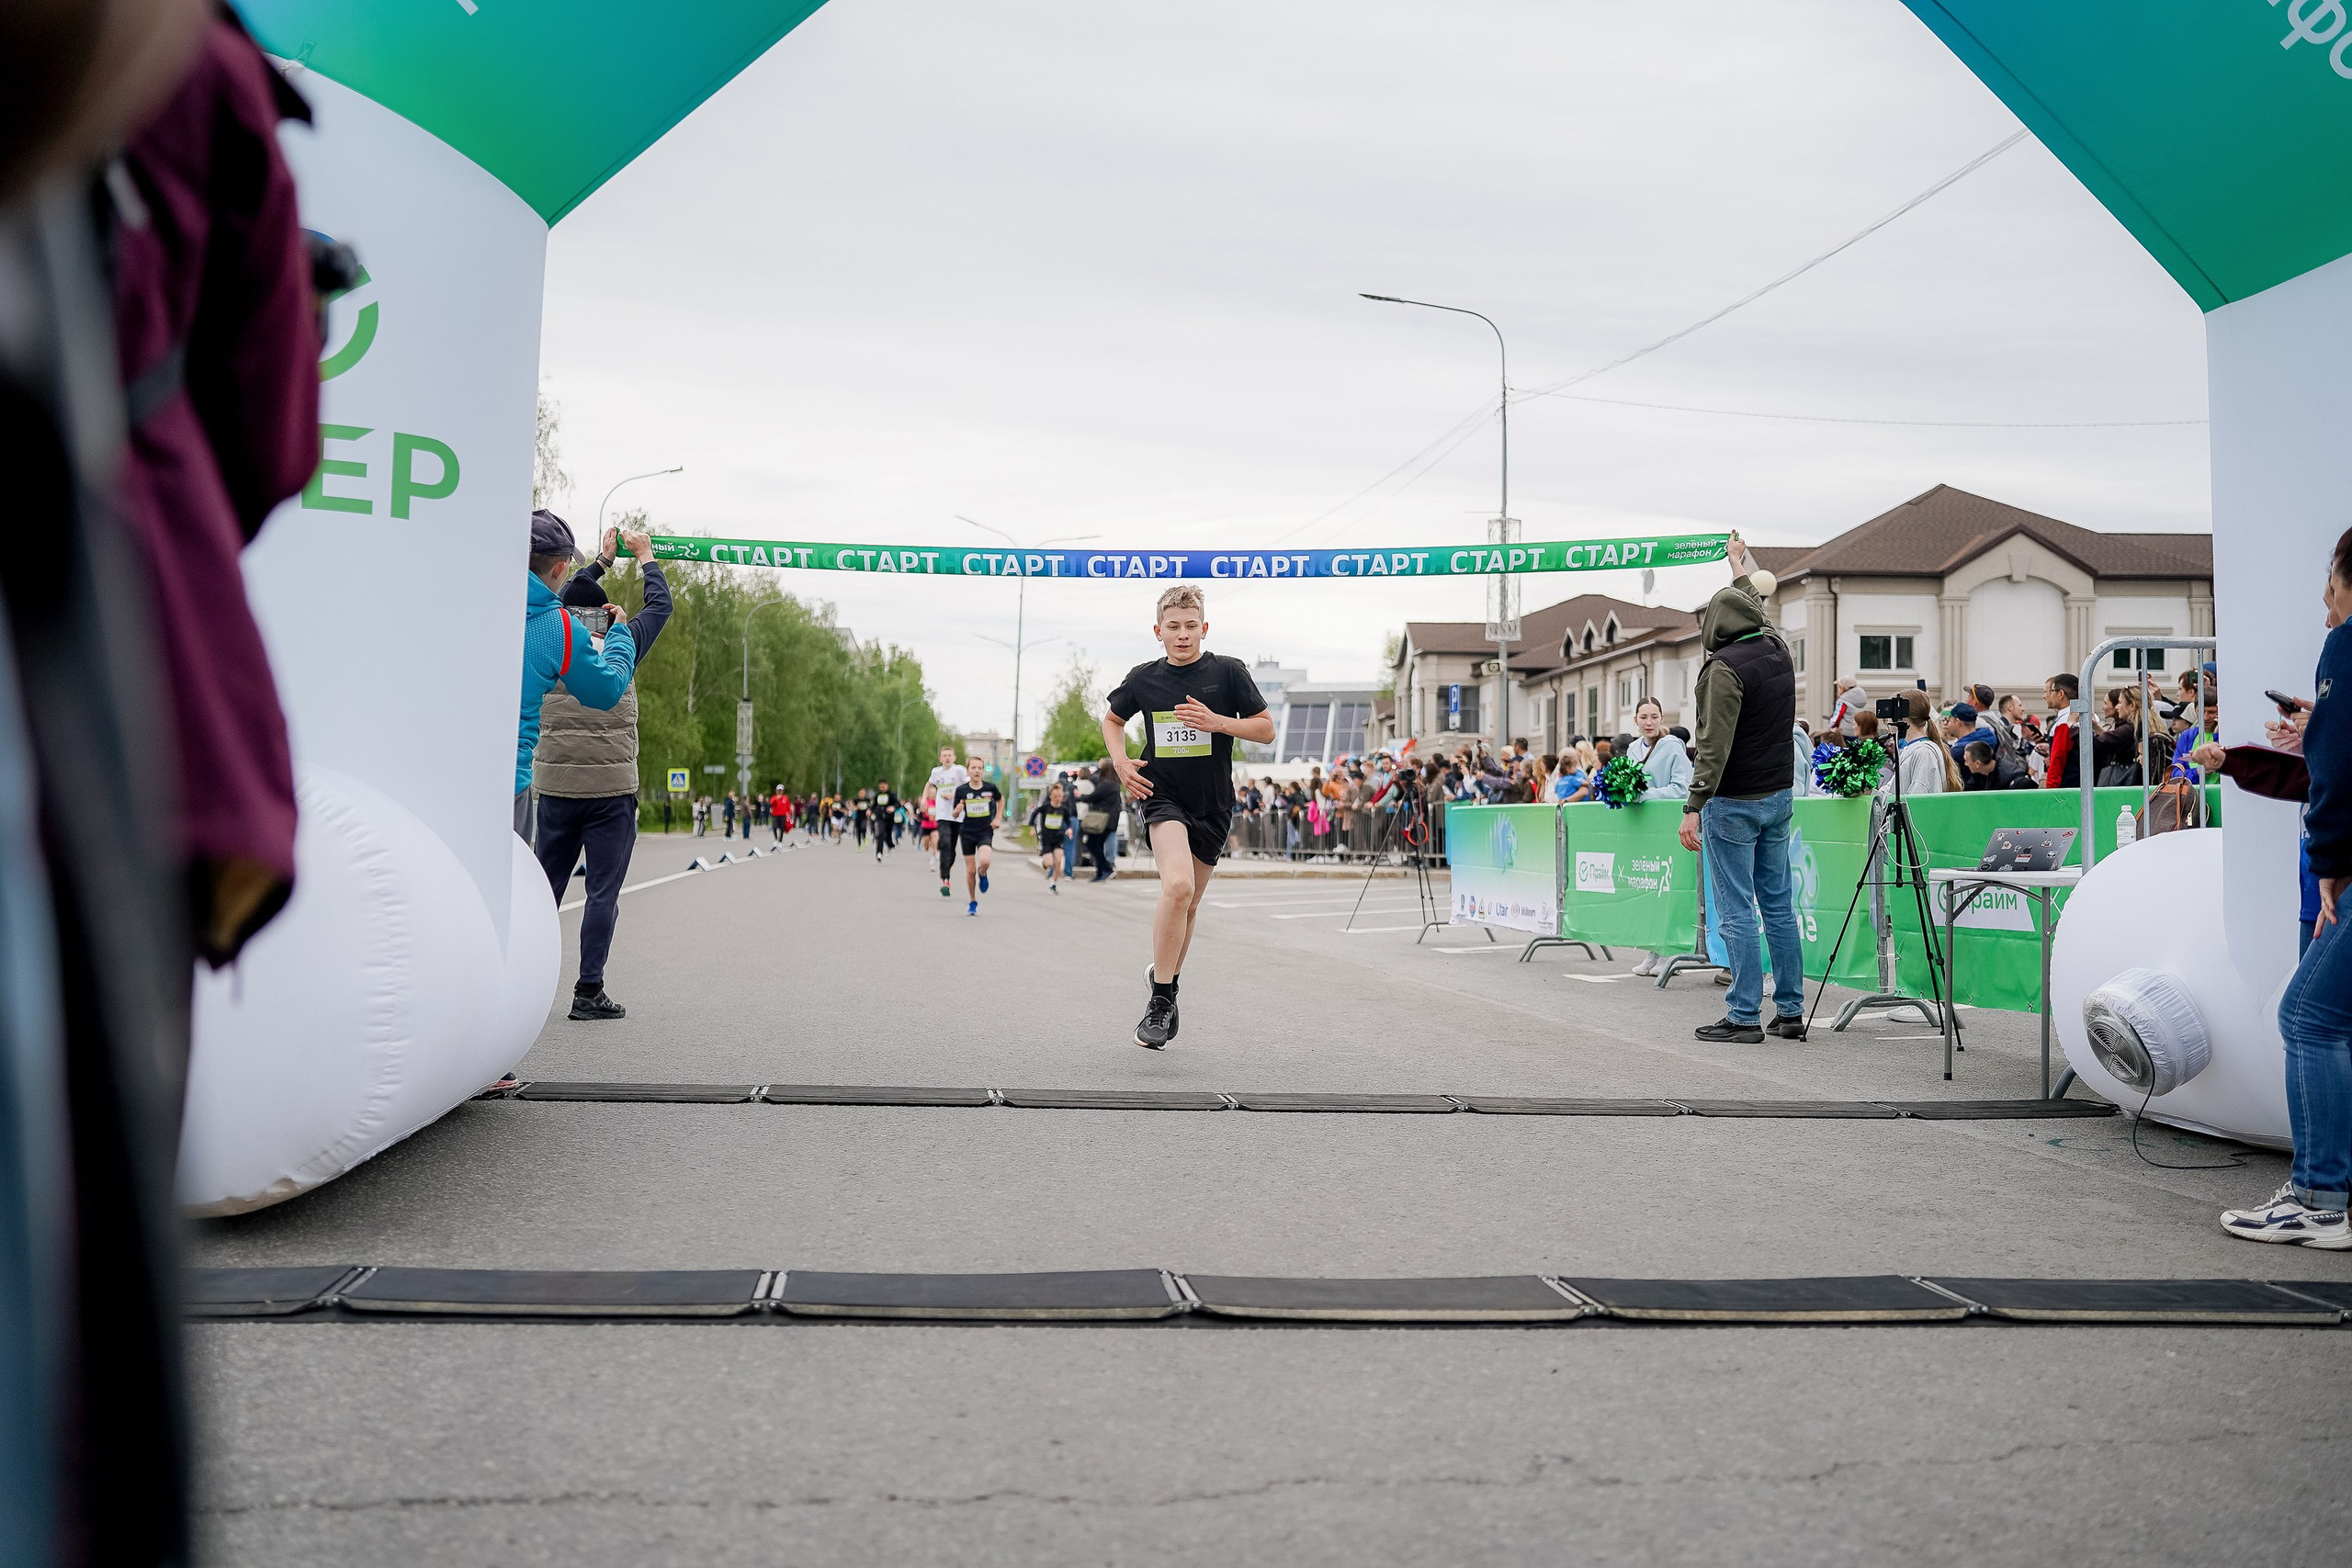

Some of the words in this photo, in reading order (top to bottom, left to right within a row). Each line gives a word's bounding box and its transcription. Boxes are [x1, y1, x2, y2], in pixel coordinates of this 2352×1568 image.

[1674, 538, 1717, 550] зелёный
[709, 544, 814, 569] СТАРТ
[836, 549, 940, 574] СТАРТ
[962, 553, 1065, 577] СТАРТ
[1087, 555, 1189, 578] СТАРТ
[1210, 555, 1310, 578] СТАРТ
[1331, 552, 1430, 576] СТАРТ
[1450, 547, 1545, 573] СТАРТ
[1566, 541, 1658, 569] СТАРТ
[1667, 548, 1713, 560] марафон
[1166, 729, 1197, 742] 3135
[1589, 863, 1610, 882] Прайм
[1631, 855, 1660, 873] зелёный
[1627, 874, 1657, 892] марафон
